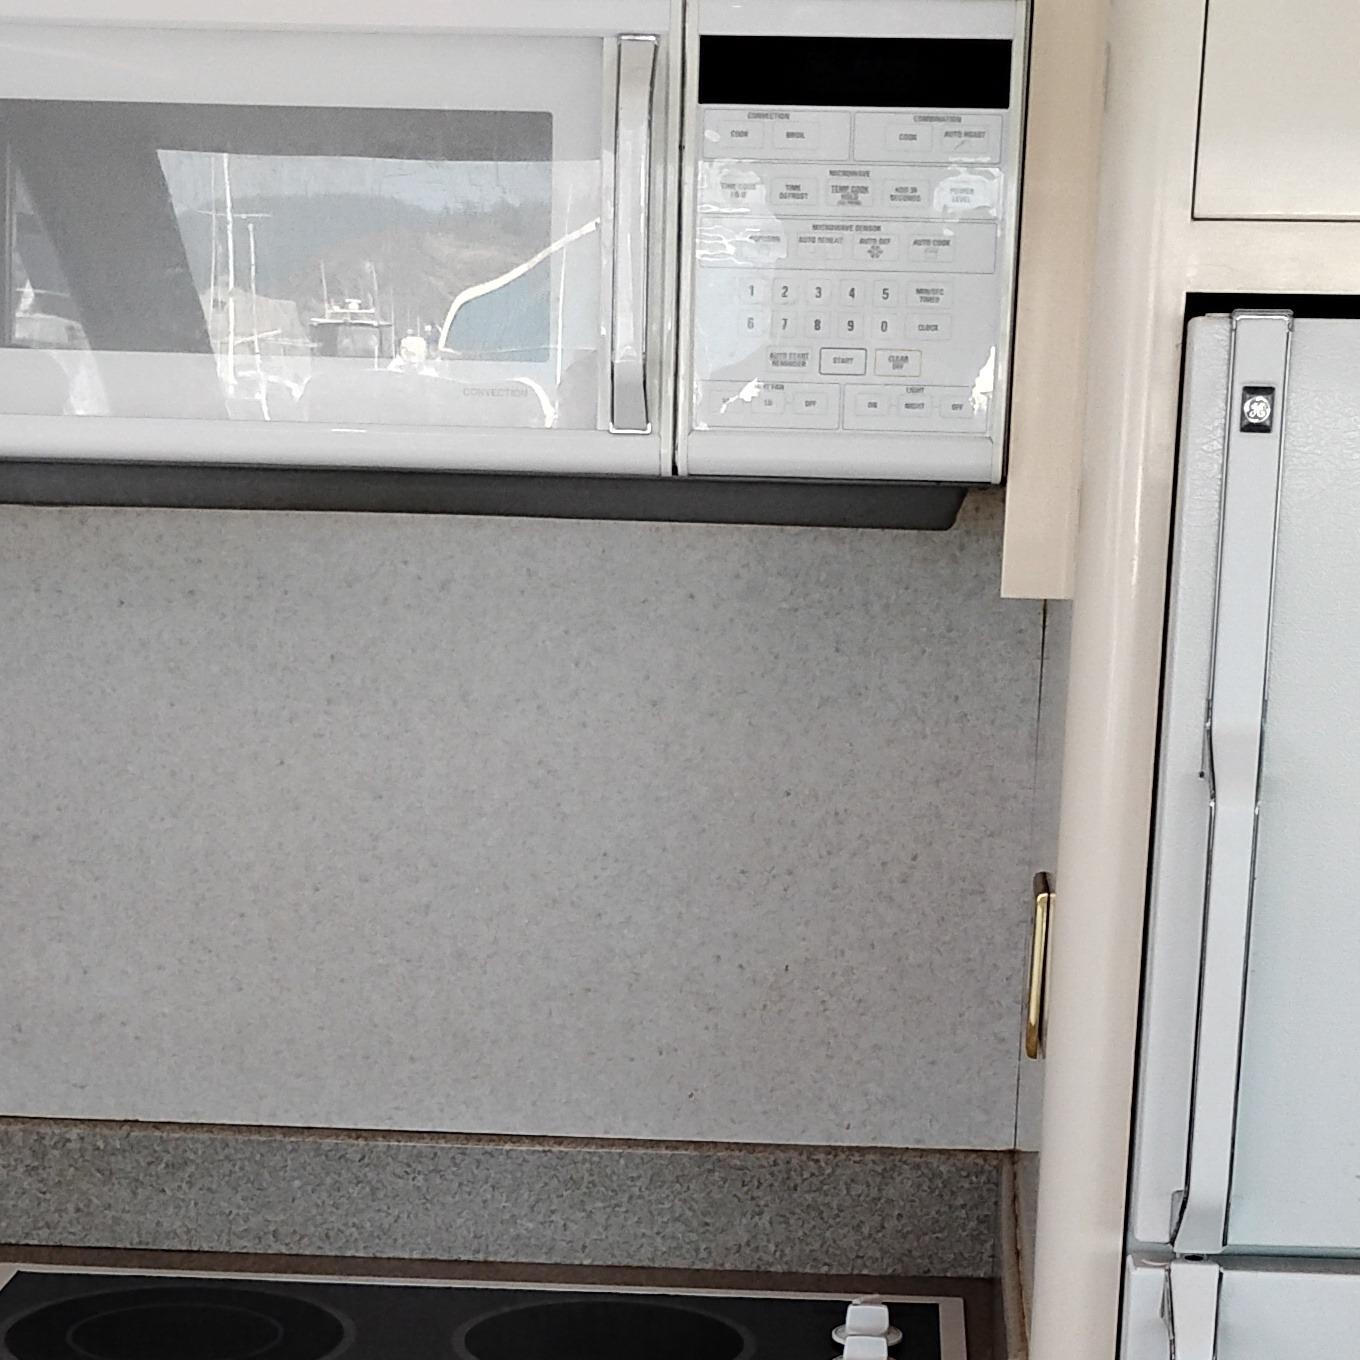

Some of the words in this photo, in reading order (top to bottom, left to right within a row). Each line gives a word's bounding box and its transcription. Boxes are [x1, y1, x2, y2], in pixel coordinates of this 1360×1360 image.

[747, 112, 790, 120] CONVECTION
[913, 115, 962, 123] COMBINATION
[730, 130, 749, 138] COOK
[899, 133, 918, 141] COOK
[851, 186, 870, 194] COOK
[779, 192, 808, 200] DEFROST
[890, 194, 921, 202] SECONDS
[855, 224, 882, 232] SENSOR
[798, 236, 816, 244] AUTO
[749, 285, 754, 297] 1
[781, 285, 789, 298] 2
[815, 286, 822, 298] 3
[848, 287, 855, 299] 4
[881, 288, 890, 300] 5
[747, 317, 755, 329] 6
[781, 318, 788, 330] 7
[814, 319, 821, 331] 8
[847, 320, 854, 332] 9
[880, 321, 888, 332] 0
[917, 324, 939, 332] CLOCK
[769, 352, 787, 360] AUTO
[888, 355, 909, 363] CLEAR
[832, 357, 854, 365] START
[905, 386, 924, 394] LIGHT
[952, 403, 964, 411] OFF
